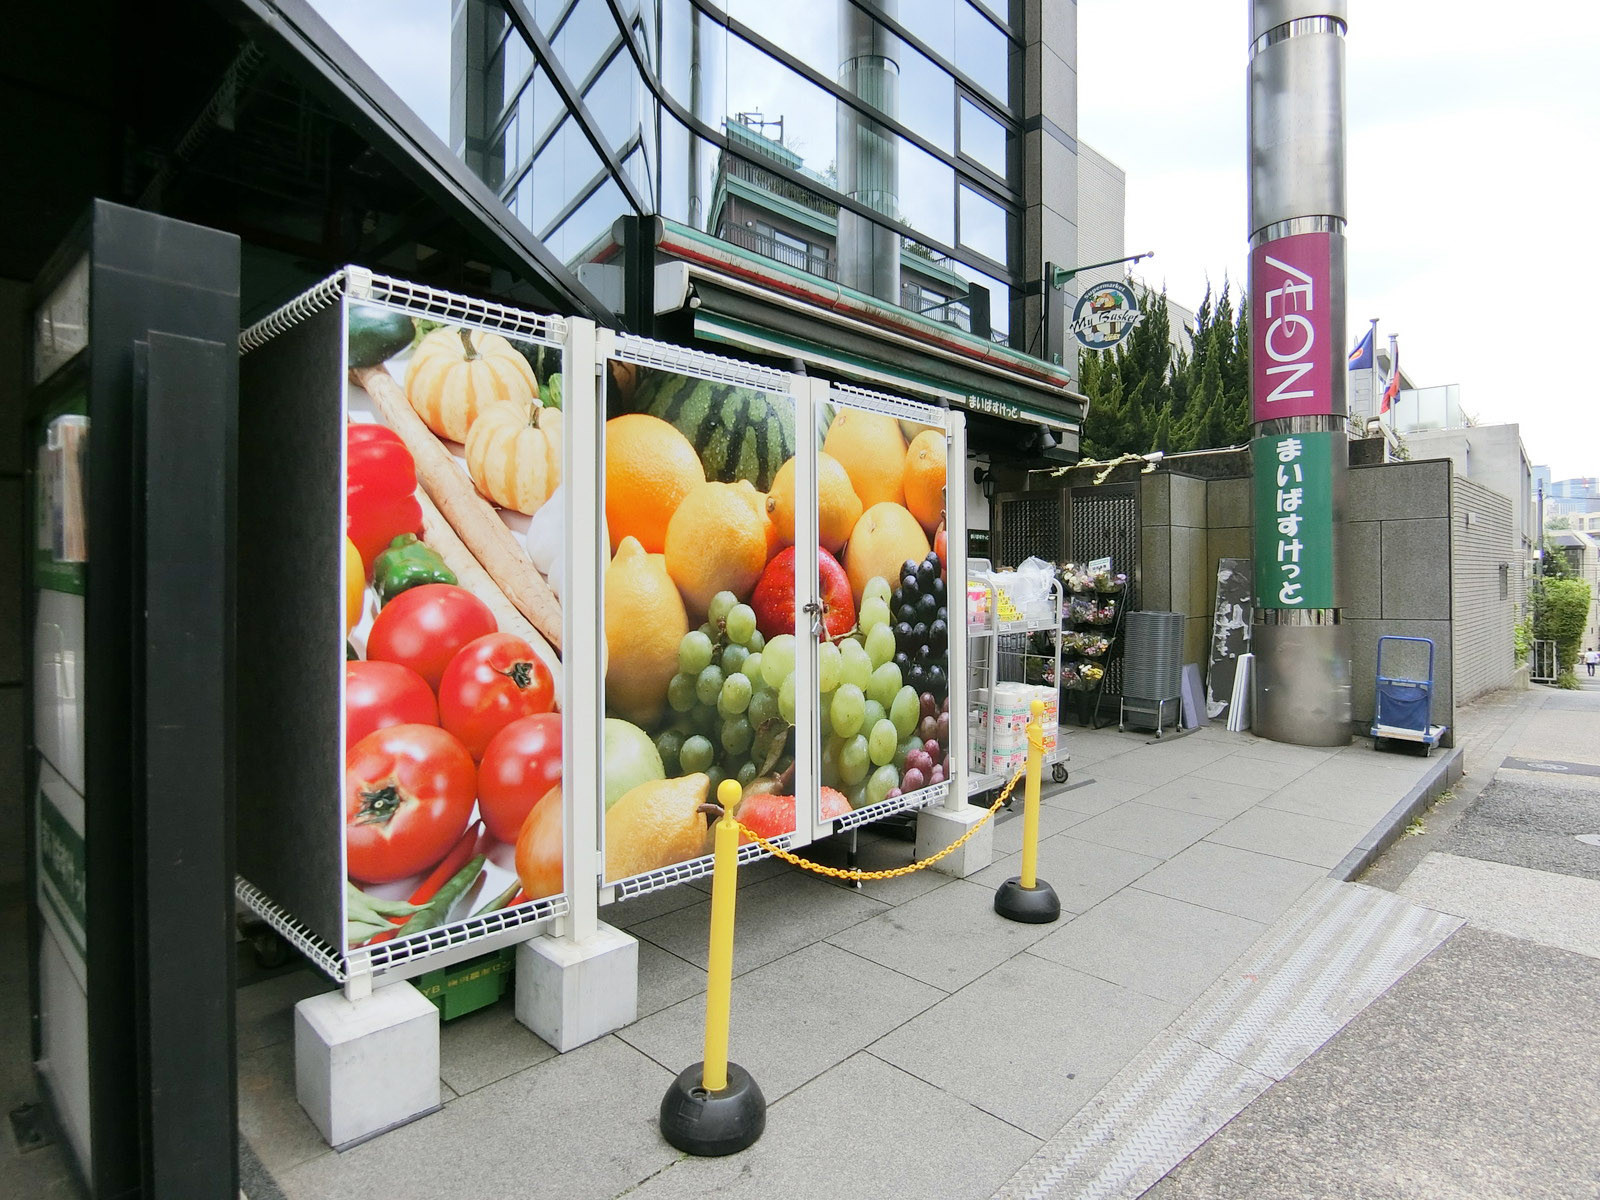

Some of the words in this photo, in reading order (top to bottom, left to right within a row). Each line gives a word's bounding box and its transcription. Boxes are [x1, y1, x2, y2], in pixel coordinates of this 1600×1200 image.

[1069, 316, 1094, 334] My
[1098, 309, 1139, 324] Basket
[969, 395, 1018, 418] まいばすけっと
[1276, 437, 1304, 605] まいばすけっと
